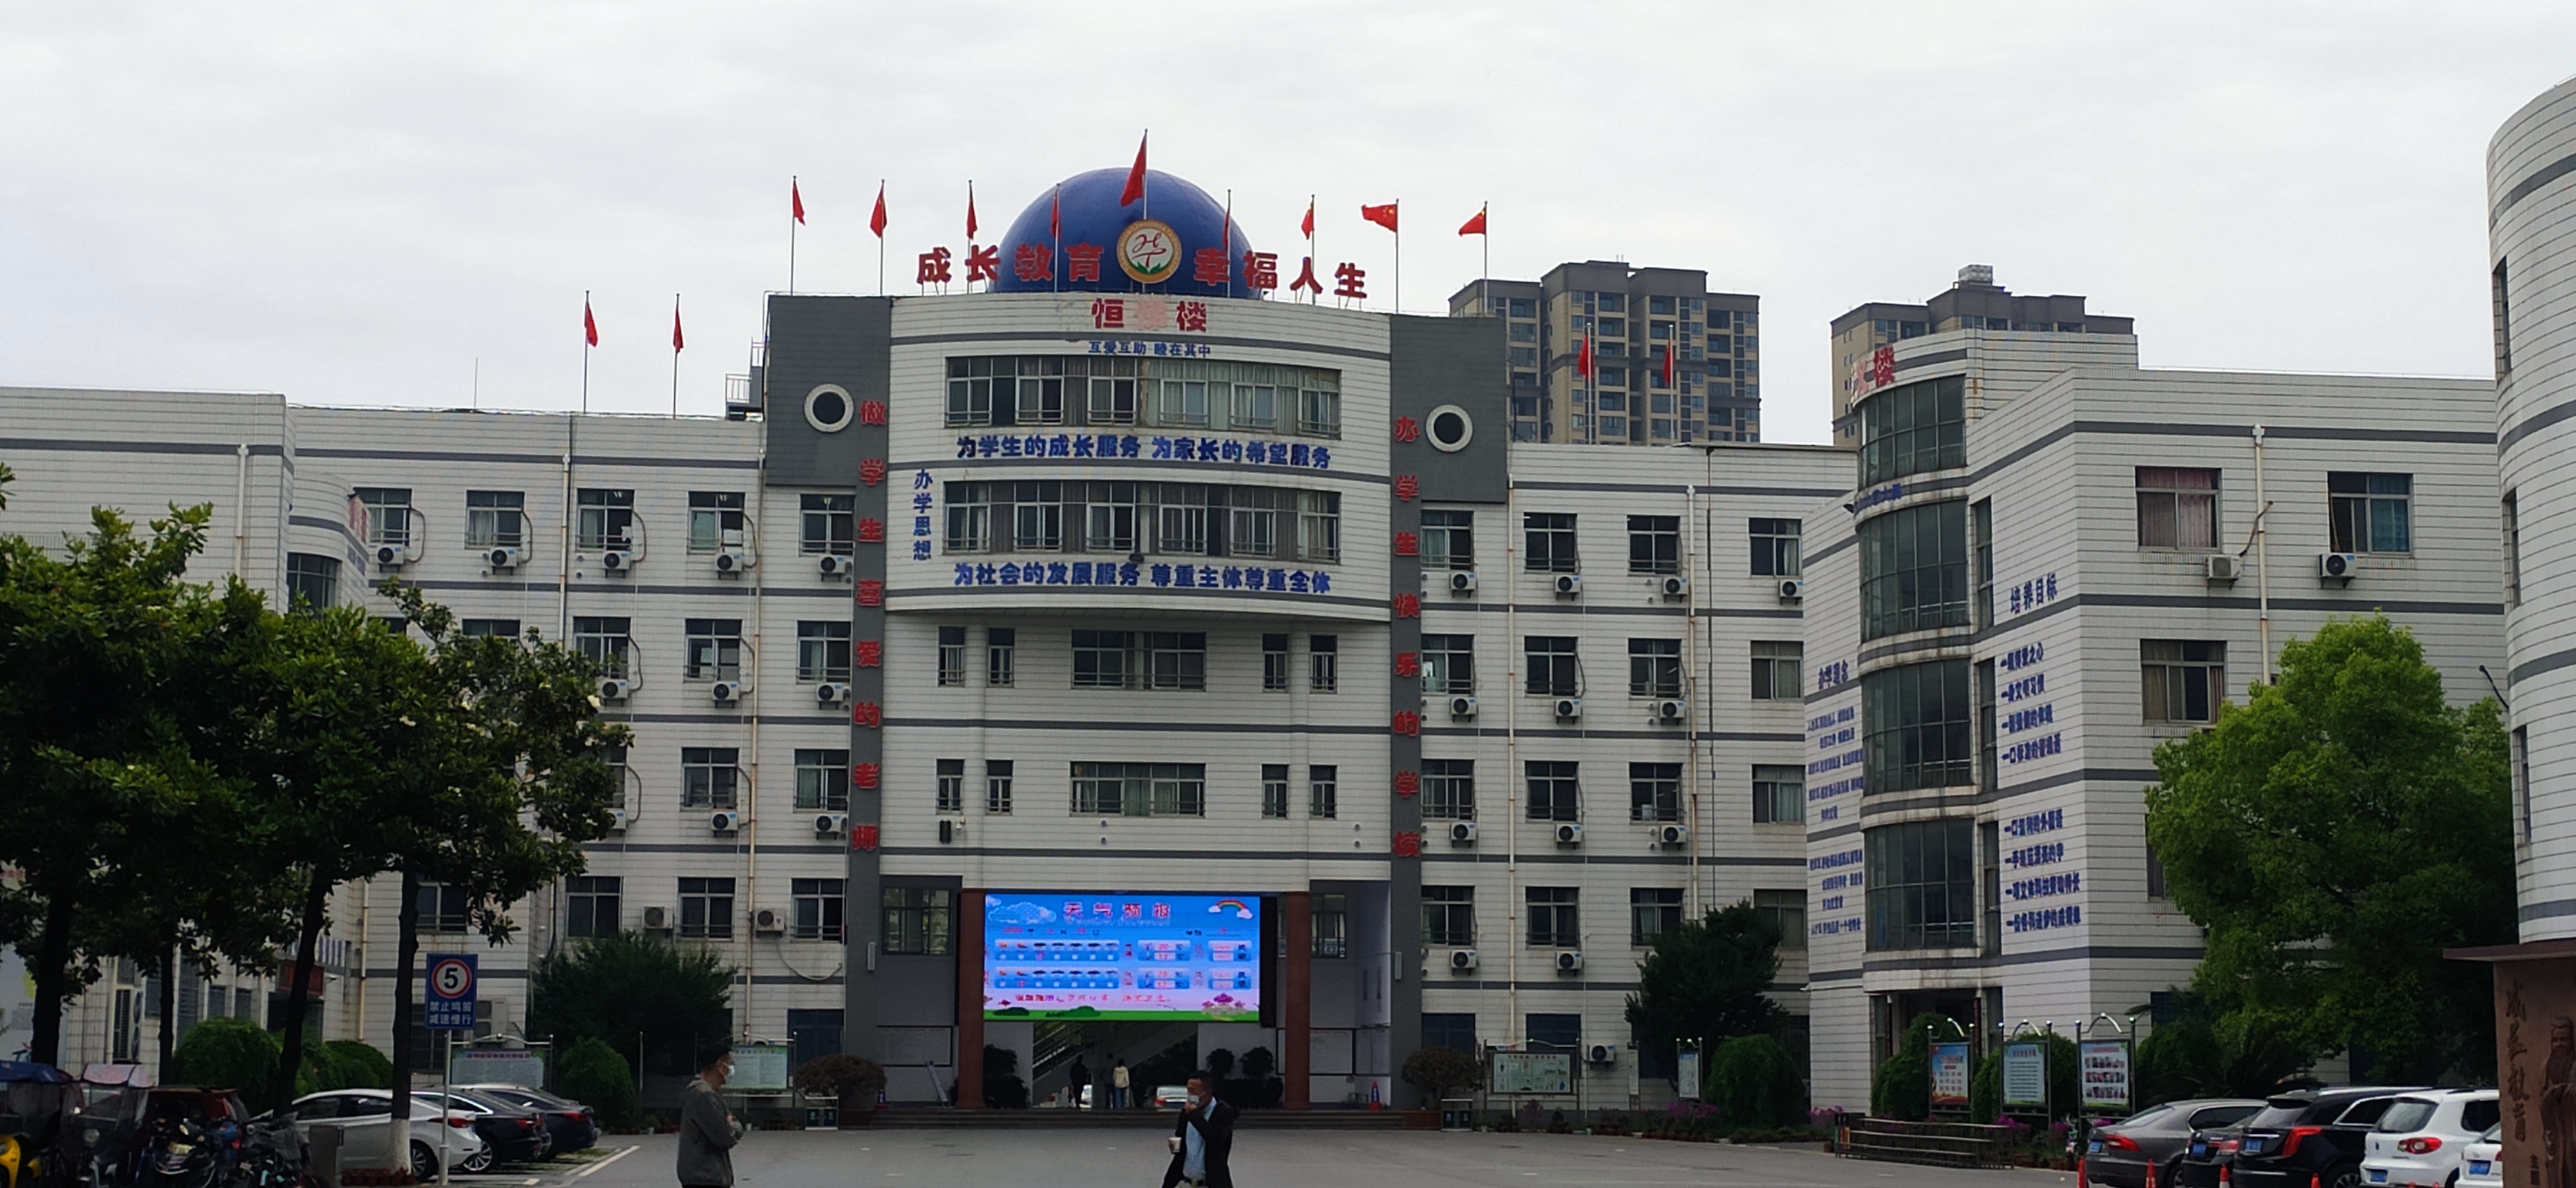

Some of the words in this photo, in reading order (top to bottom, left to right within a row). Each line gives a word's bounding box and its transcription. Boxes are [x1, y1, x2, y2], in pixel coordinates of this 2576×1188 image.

[916, 244, 1104, 285] 成长教育
[1193, 247, 1368, 299] 幸福人生
[1091, 297, 1207, 332] 恒楼
[956, 434, 1141, 459] 为学生的成长服务
[1151, 436, 1332, 469] 为家长的希望服务
[913, 468, 933, 560] 办学思想
[954, 561, 1141, 586] 为社会的发展服务
[1150, 564, 1331, 593] 尊重主体尊重全体
[2010, 572, 2058, 615] 培养目标
[851, 399, 886, 851] 做学生喜爱的老师
[1393, 416, 1421, 857] 办学生快乐的学校
[1063, 902, 1171, 919] 天气预报
[444, 967, 459, 989] 5
[429, 1013, 471, 1025] 减速慢行
[430, 1001, 472, 1013] 禁止鸣笛
